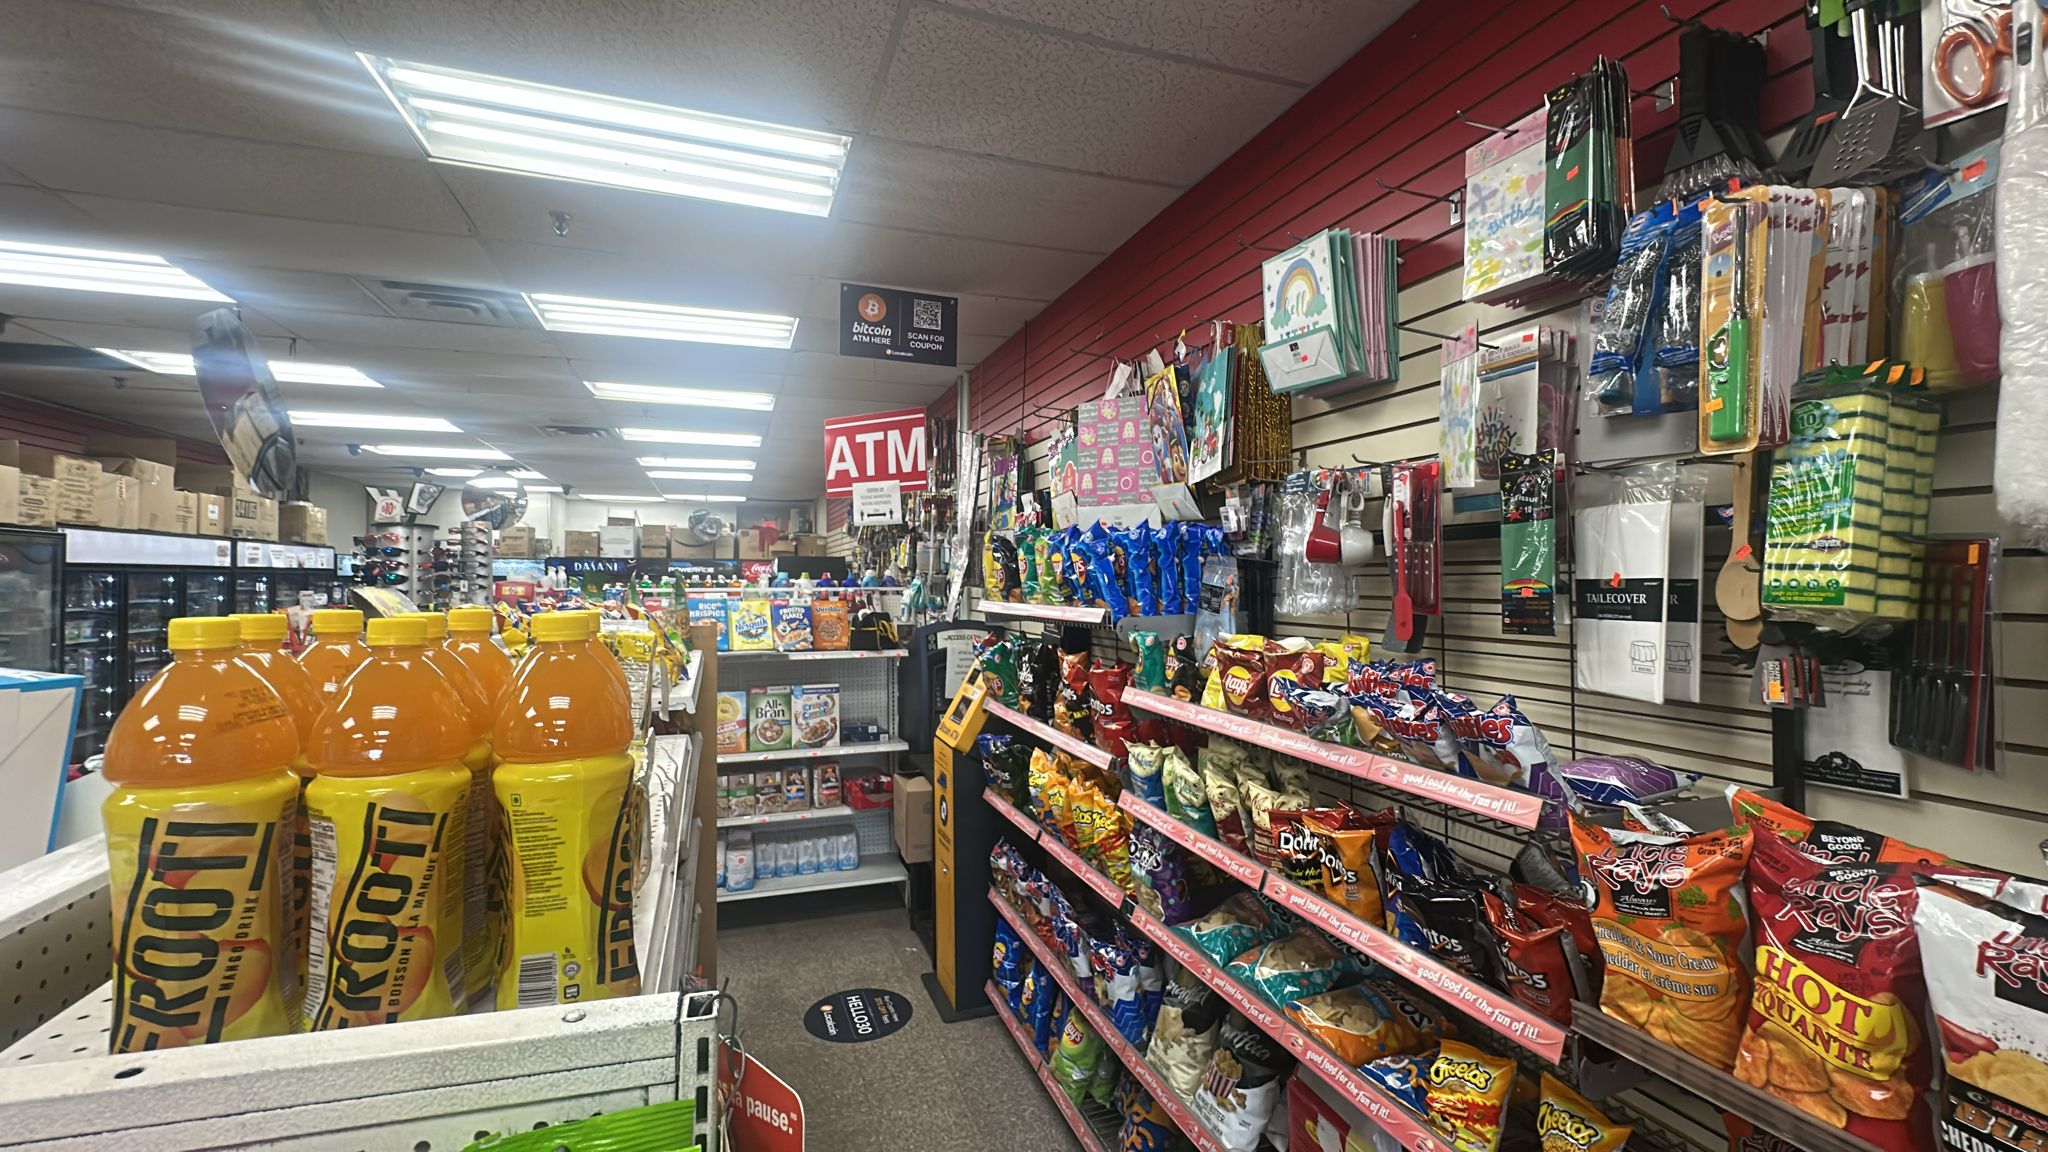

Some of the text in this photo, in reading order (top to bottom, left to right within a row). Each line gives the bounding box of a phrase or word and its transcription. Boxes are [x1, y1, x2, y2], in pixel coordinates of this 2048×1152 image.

[852, 321, 892, 337] bitcoin
[907, 332, 945, 343] SCAN FOR
[852, 335, 891, 345] ATM HERE
[909, 341, 943, 351] COUPON
[1799, 413, 1817, 428] 10
[827, 426, 926, 481] ATM
[574, 560, 619, 572] DASANI
[698, 602, 717, 610] RICE
[779, 606, 806, 615] FROSTED
[815, 606, 844, 614] Shreddies
[735, 617, 769, 633] Nesquik
[783, 613, 804, 621] FLAKES
[764, 699, 782, 709] All-
[755, 708, 785, 719] Bran
[1339, 755, 1348, 765] of
[1402, 772, 1517, 813] good food for the fun of it!
[1280, 832, 1320, 851] Dorit
[1821, 834, 1865, 843] BEYOND
[1827, 843, 1862, 851] GOOD!
[1697, 847, 1717, 855] Gras
[235, 896, 260, 939] DRINK
[1289, 894, 1370, 943] good food for the fun of it!
[1422, 927, 1463, 952] ritos
[388, 953, 411, 1007] BOISSON
[409, 915, 420, 929] LA
[1634, 937, 1646, 953] &
[1646, 943, 1675, 967] Sour
[1677, 951, 1718, 971] Cream
[218, 946, 246, 991] MANGO
[1500, 955, 1547, 990] ritos
[1641, 966, 1652, 982] et
[1693, 983, 1719, 996] sure
[1765, 948, 1873, 1037] HOT
[1417, 966, 1539, 1039] good food for the fun of it!
[846, 995, 873, 1034] HELLO30
[1430, 1057, 1492, 1091] Cheetos
[1306, 1050, 1390, 1118] good food for the fun of it!
[1537, 1101, 1601, 1148] Cheetos
